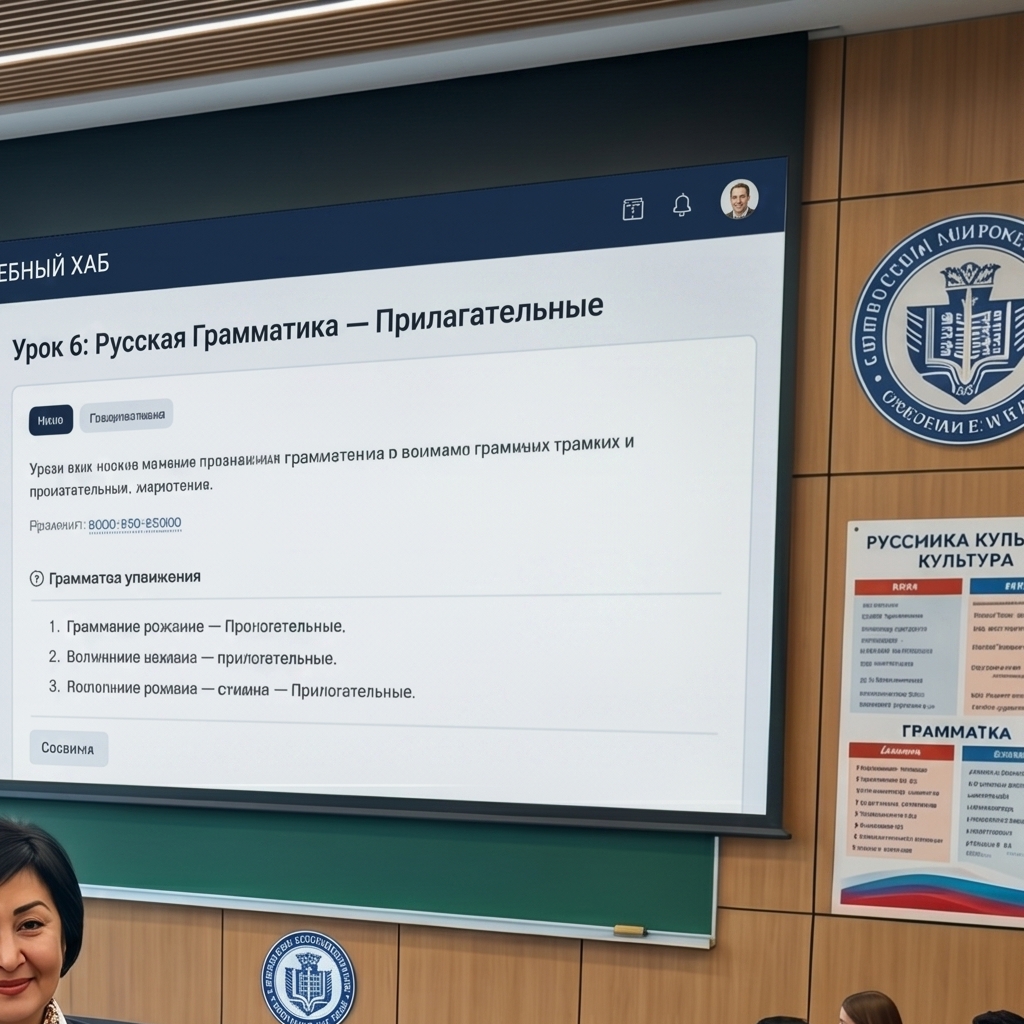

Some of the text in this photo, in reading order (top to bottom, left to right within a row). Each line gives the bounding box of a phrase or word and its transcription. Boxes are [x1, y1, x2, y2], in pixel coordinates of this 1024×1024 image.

[70, 252, 110, 276] ХАБ
[11, 338, 64, 366] Урок
[69, 333, 89, 357] 6:
[95, 330, 186, 360] Русская
[193, 318, 339, 352] Грамматика
[376, 296, 604, 339] Прилагательные
[624, 436, 635, 449] и
[918, 552, 1014, 569] КУЛЬТУРА
[49, 619, 60, 633] 1.
[66, 619, 141, 636] Граммание
[48, 649, 61, 663] 2.
[48, 678, 61, 693] 3.
[902, 724, 1012, 741] ГРАММАТКА
